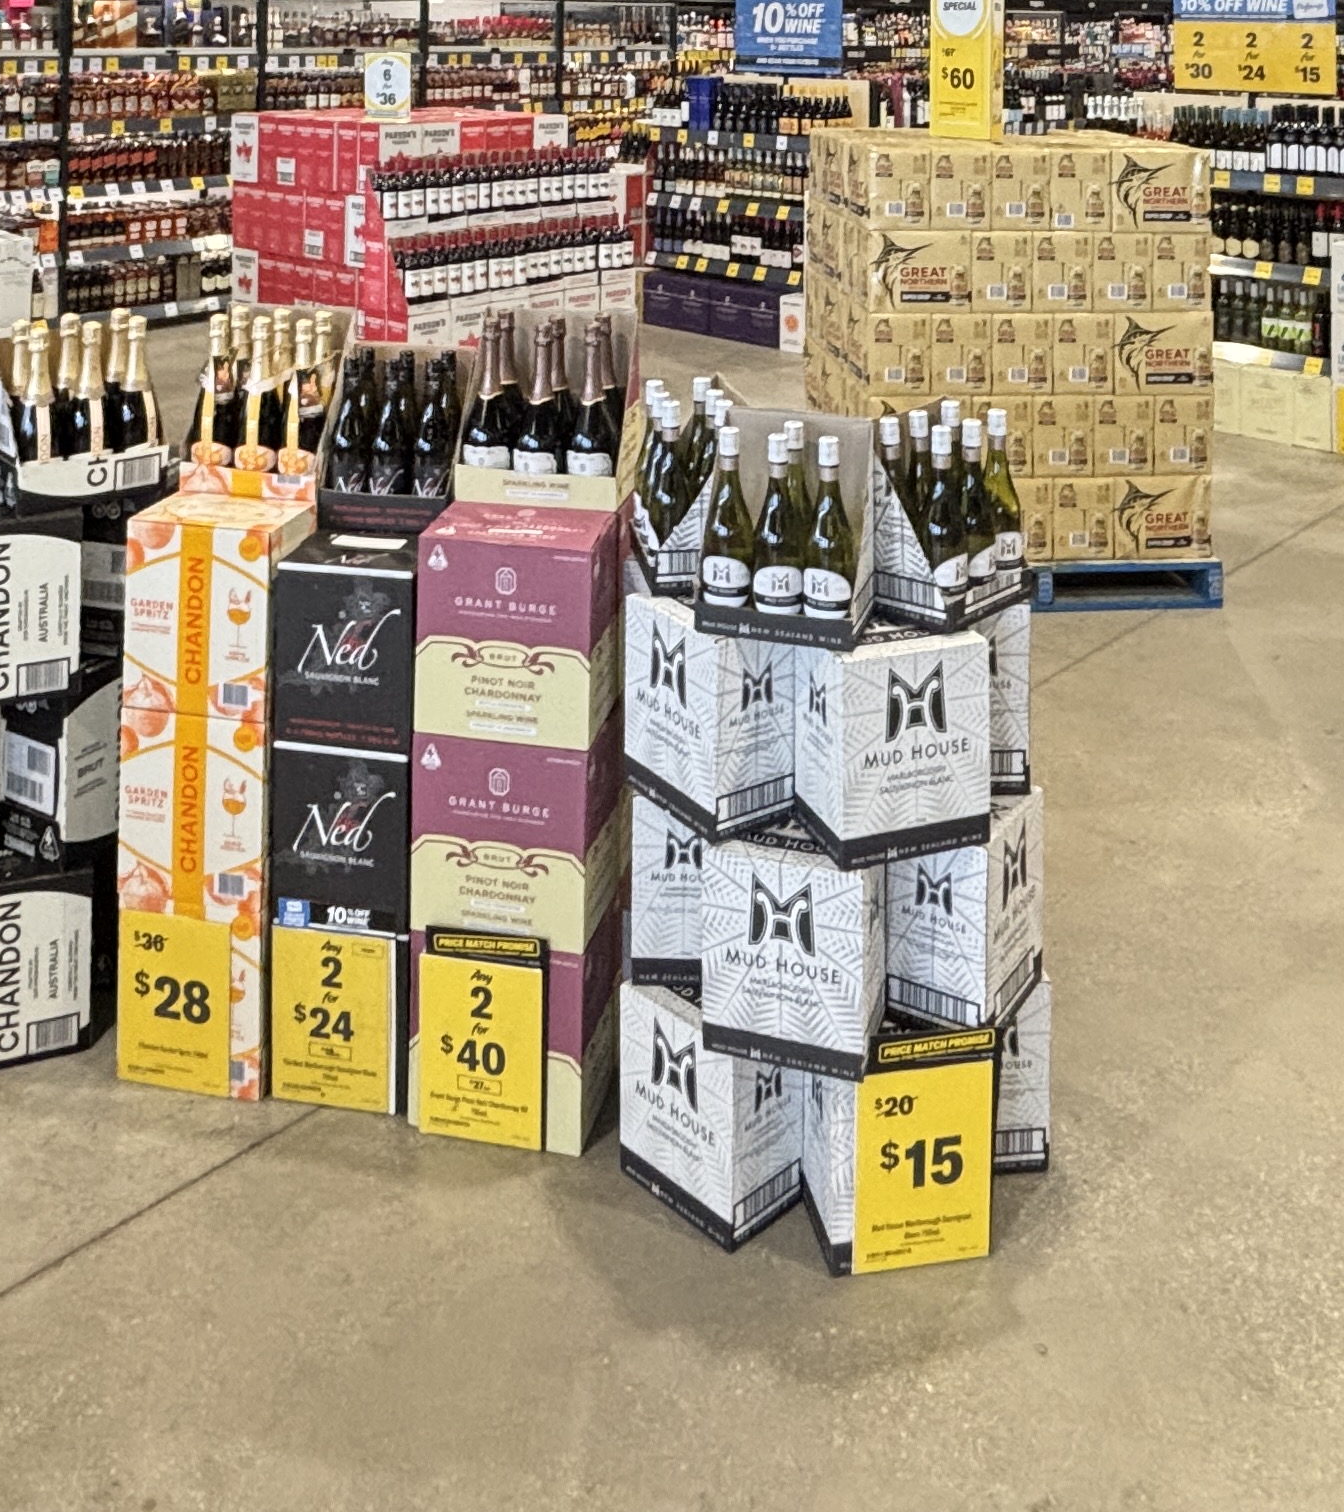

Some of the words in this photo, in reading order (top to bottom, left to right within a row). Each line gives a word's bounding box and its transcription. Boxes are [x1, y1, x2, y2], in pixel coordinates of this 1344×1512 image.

[798, 2, 825, 17] OFF
[943, 1, 977, 11] SPECIAL
[1193, 31, 1204, 47] 2
[1246, 32, 1257, 48] 2
[1301, 33, 1313, 49] 2
[383, 68, 392, 81] 6
[942, 66, 974, 89] $60
[1185, 63, 1212, 79] $30
[1238, 65, 1265, 81] $24
[1295, 65, 1320, 82] $15
[376, 92, 396, 105] $36
[1143, 187, 1188, 198] GREAT
[900, 267, 947, 278] GREAT
[1145, 349, 1190, 359] GREAT
[1145, 513, 1189, 524] GREAT
[37, 582, 49, 643] AUSTRALIA
[130, 597, 173, 611] GARDEN
[454, 595, 502, 611] GRANT
[508, 601, 557, 616] BURGE
[134, 607, 171, 620] SPRITZ
[185, 555, 204, 685] CHANDON
[297, 608, 402, 674] Ned
[471, 675, 505, 688] PINOT
[507, 678, 535, 690] NOIR
[464, 686, 542, 703] CHARDONNAY
[635, 687, 662, 715] MUD
[663, 703, 701, 740] HOUSE
[728, 712, 751, 728] MUD
[753, 704, 785, 721] HOUSE
[863, 748, 903, 770] MUD
[911, 738, 970, 762] HOUSE
[124, 784, 168, 799] GARDEN
[128, 795, 166, 809] SPRITZ
[180, 745, 199, 874] CHANDON
[448, 795, 496, 811] GRANT
[502, 802, 550, 818] BURGE
[292, 791, 397, 852] Ned
[465, 874, 498, 887] PINOT
[900, 904, 926, 922] MUD
[929, 912, 967, 935] HOUSE
[320, 939, 343, 956] Any
[321, 956, 343, 989] 2
[724, 948, 767, 970] MUD
[775, 955, 842, 986] HOUSE
[470, 969, 493, 985] Any
[135, 968, 211, 1025] $28
[321, 990, 340, 1005] for
[470, 986, 493, 1020] 2
[294, 1002, 354, 1042] $24
[471, 1022, 489, 1036] for
[441, 1034, 506, 1076] $40
[882, 1045, 912, 1058] PRICE
[913, 1039, 947, 1054] MATCH
[635, 1080, 665, 1112] MUD
[669, 1102, 716, 1146] HOUSE
[875, 1095, 914, 1118] $20
[880, 1134, 963, 1189] $15
